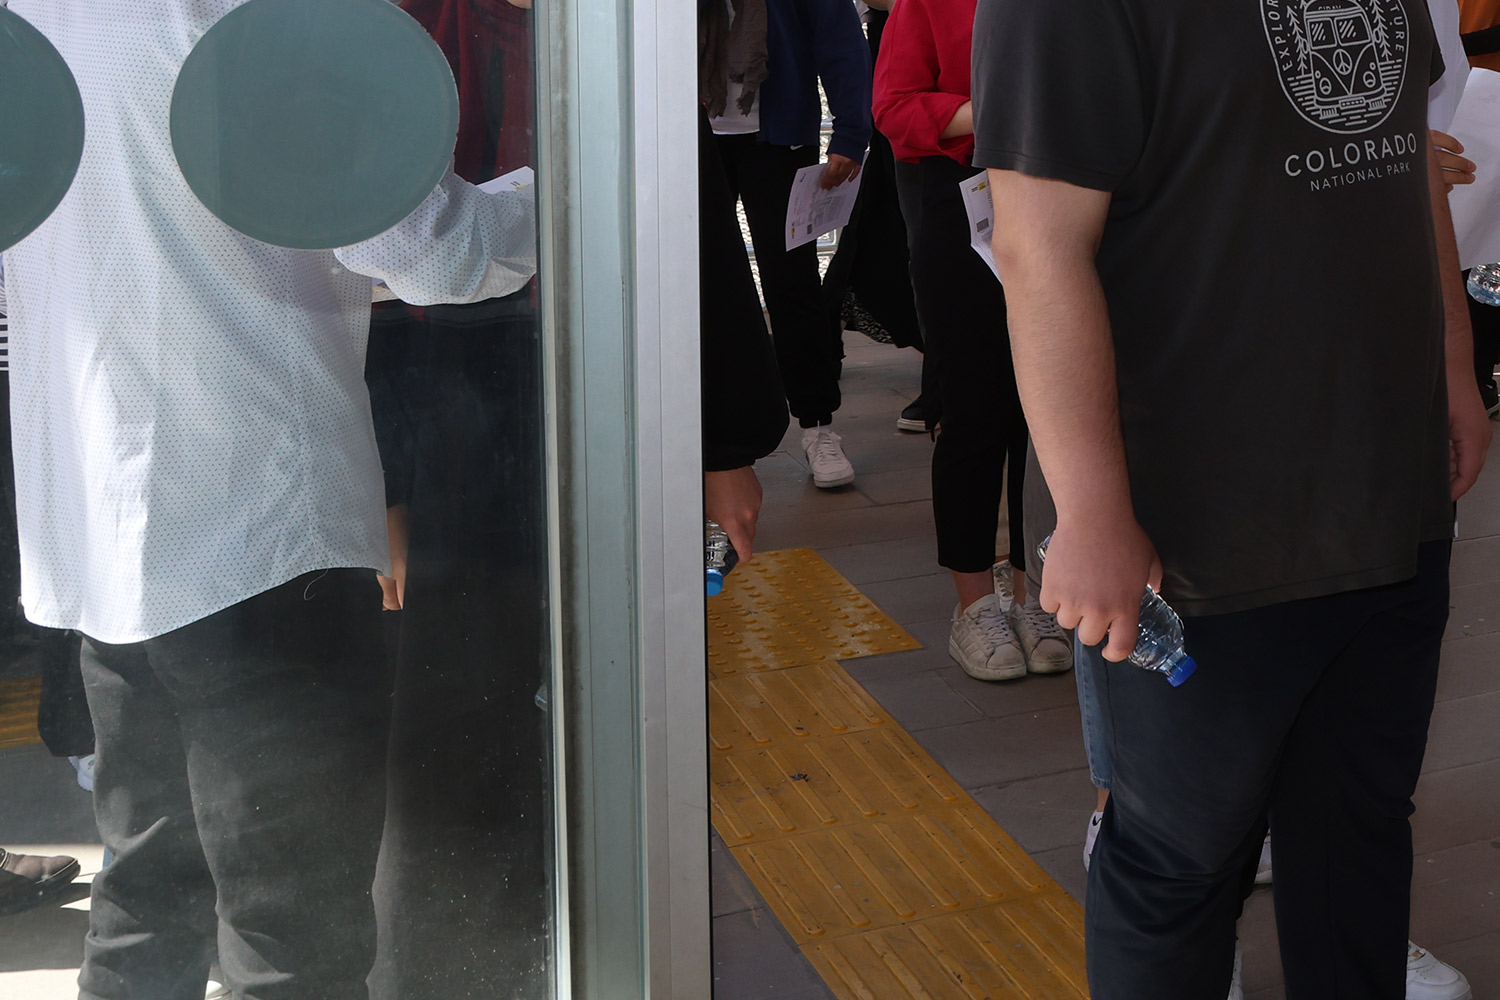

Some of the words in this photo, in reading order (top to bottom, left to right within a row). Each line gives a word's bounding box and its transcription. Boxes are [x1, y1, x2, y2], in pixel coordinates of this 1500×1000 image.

[1285, 132, 1417, 177] COLORADO
[1310, 167, 1383, 191] NATIONAL
[1387, 161, 1411, 176] PARK
